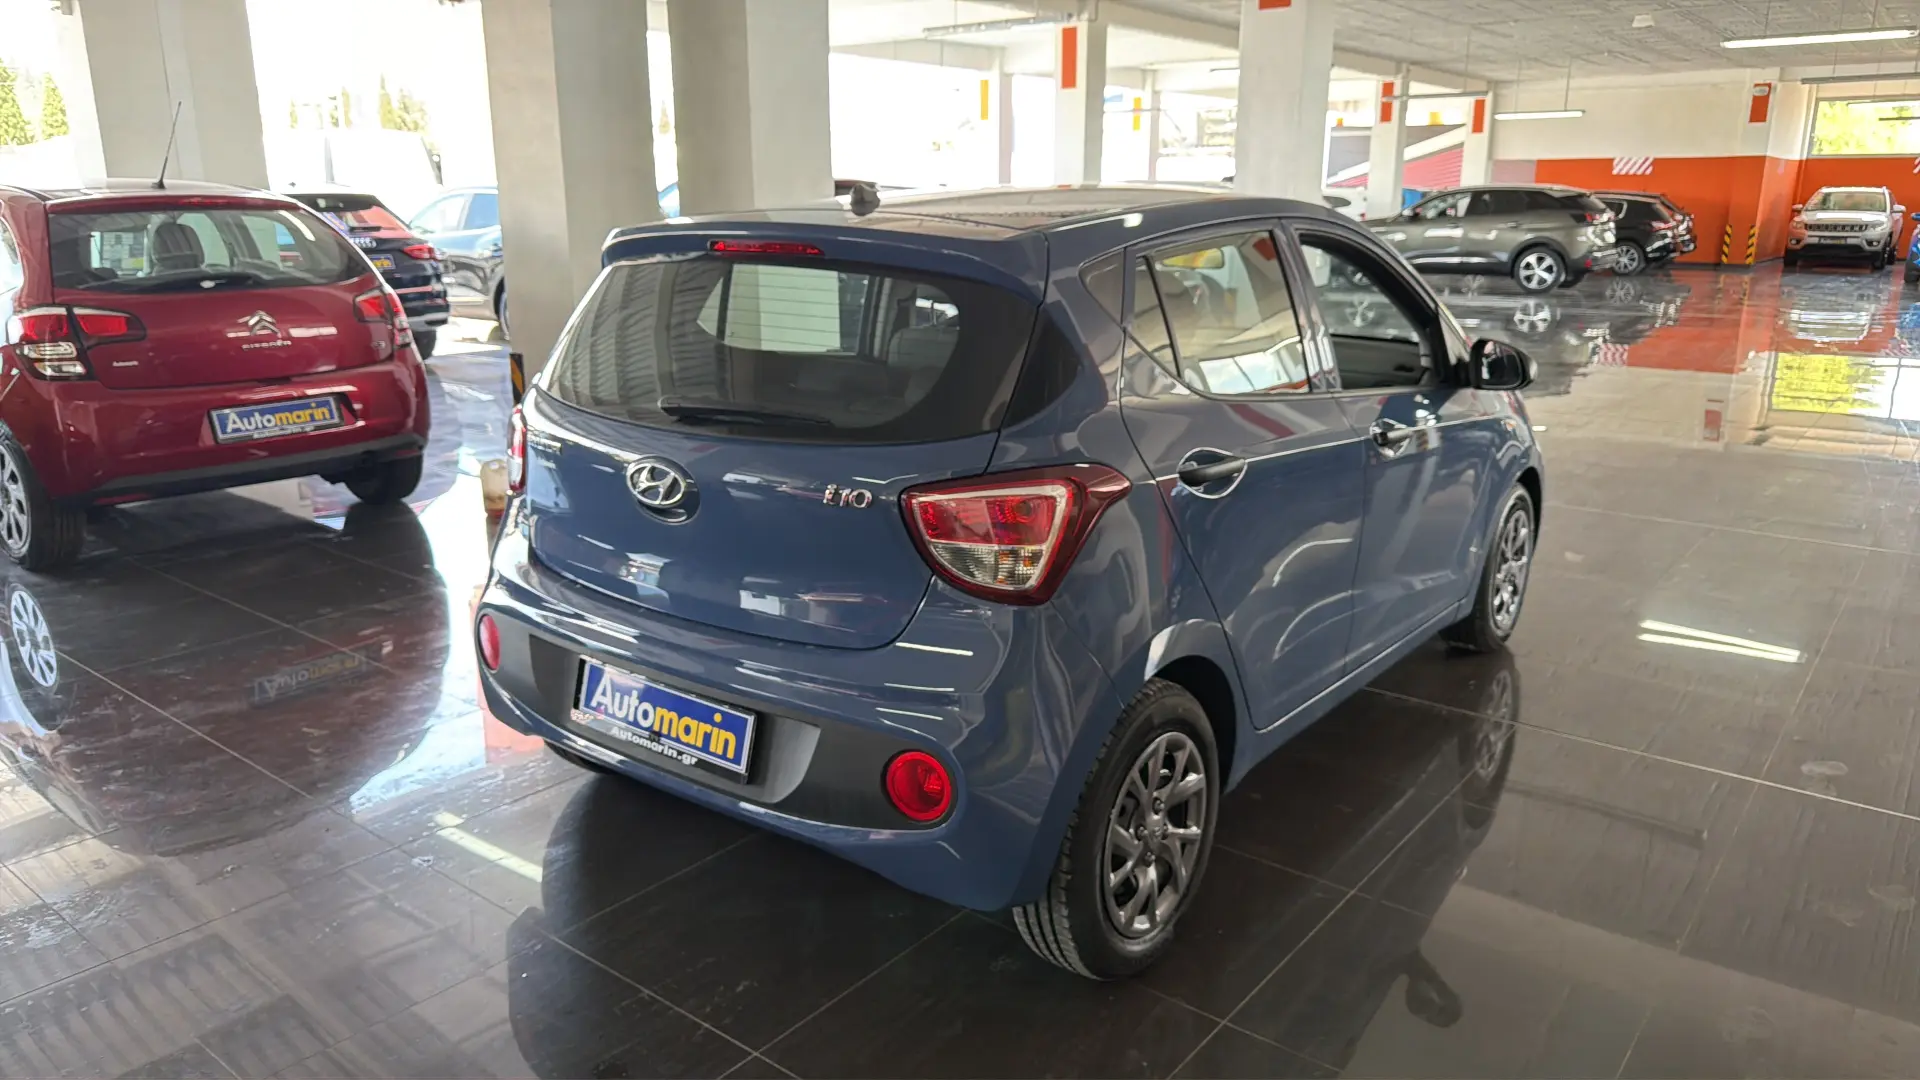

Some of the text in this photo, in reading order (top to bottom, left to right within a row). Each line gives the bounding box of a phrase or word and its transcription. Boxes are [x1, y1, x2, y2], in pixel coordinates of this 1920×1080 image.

[226, 402, 331, 433] Automarin
[823, 484, 872, 508] i10
[591, 671, 737, 760] Automarin
[611, 726, 698, 766] Automarin.gr
